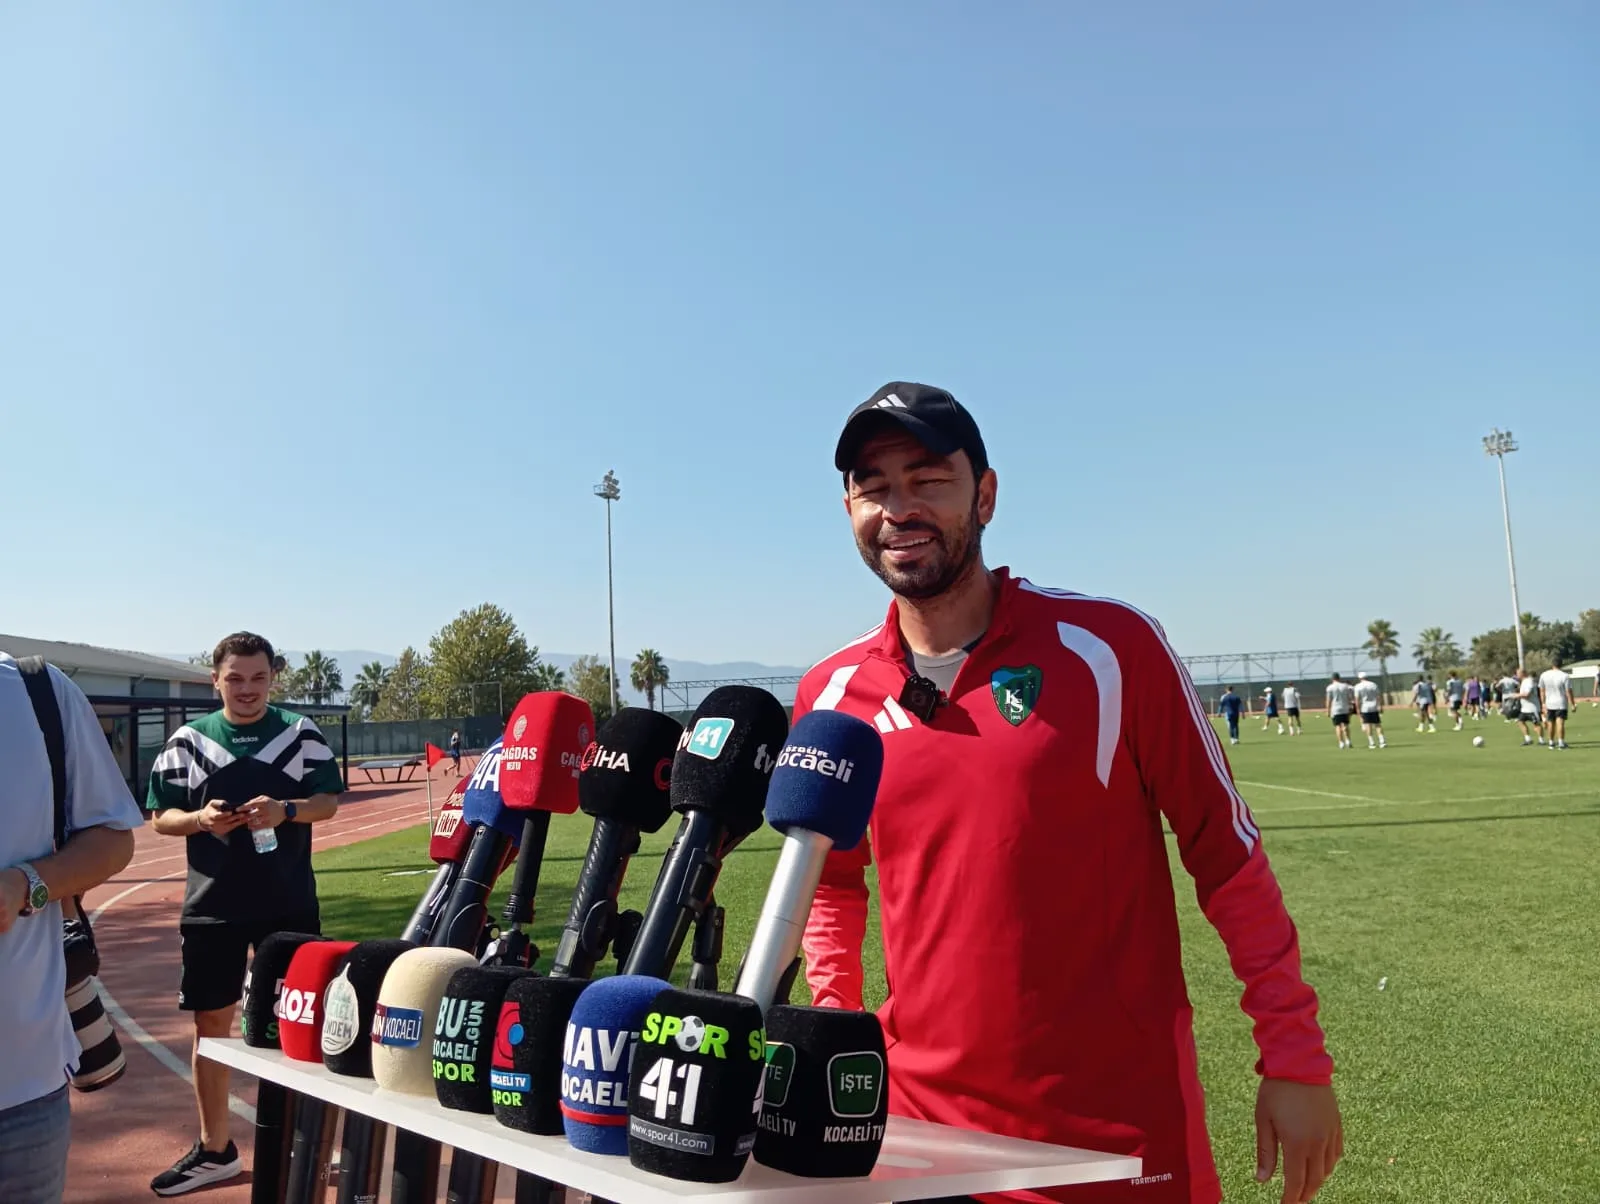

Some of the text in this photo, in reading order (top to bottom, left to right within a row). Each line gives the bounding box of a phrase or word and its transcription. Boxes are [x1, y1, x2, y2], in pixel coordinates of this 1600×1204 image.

[694, 726, 723, 749] 41
[384, 1015, 422, 1041] KOCAELİ
[435, 996, 486, 1041] BU GÜN
[432, 1060, 476, 1082] SPOR
[840, 1073, 873, 1093] İŞTE
[562, 1071, 629, 1107] OCAEL
[639, 1057, 702, 1126] 41
[631, 1121, 709, 1151] www.spor41.com
[782, 1118, 797, 1137] TV
[823, 1121, 872, 1143] KOCAELİ
